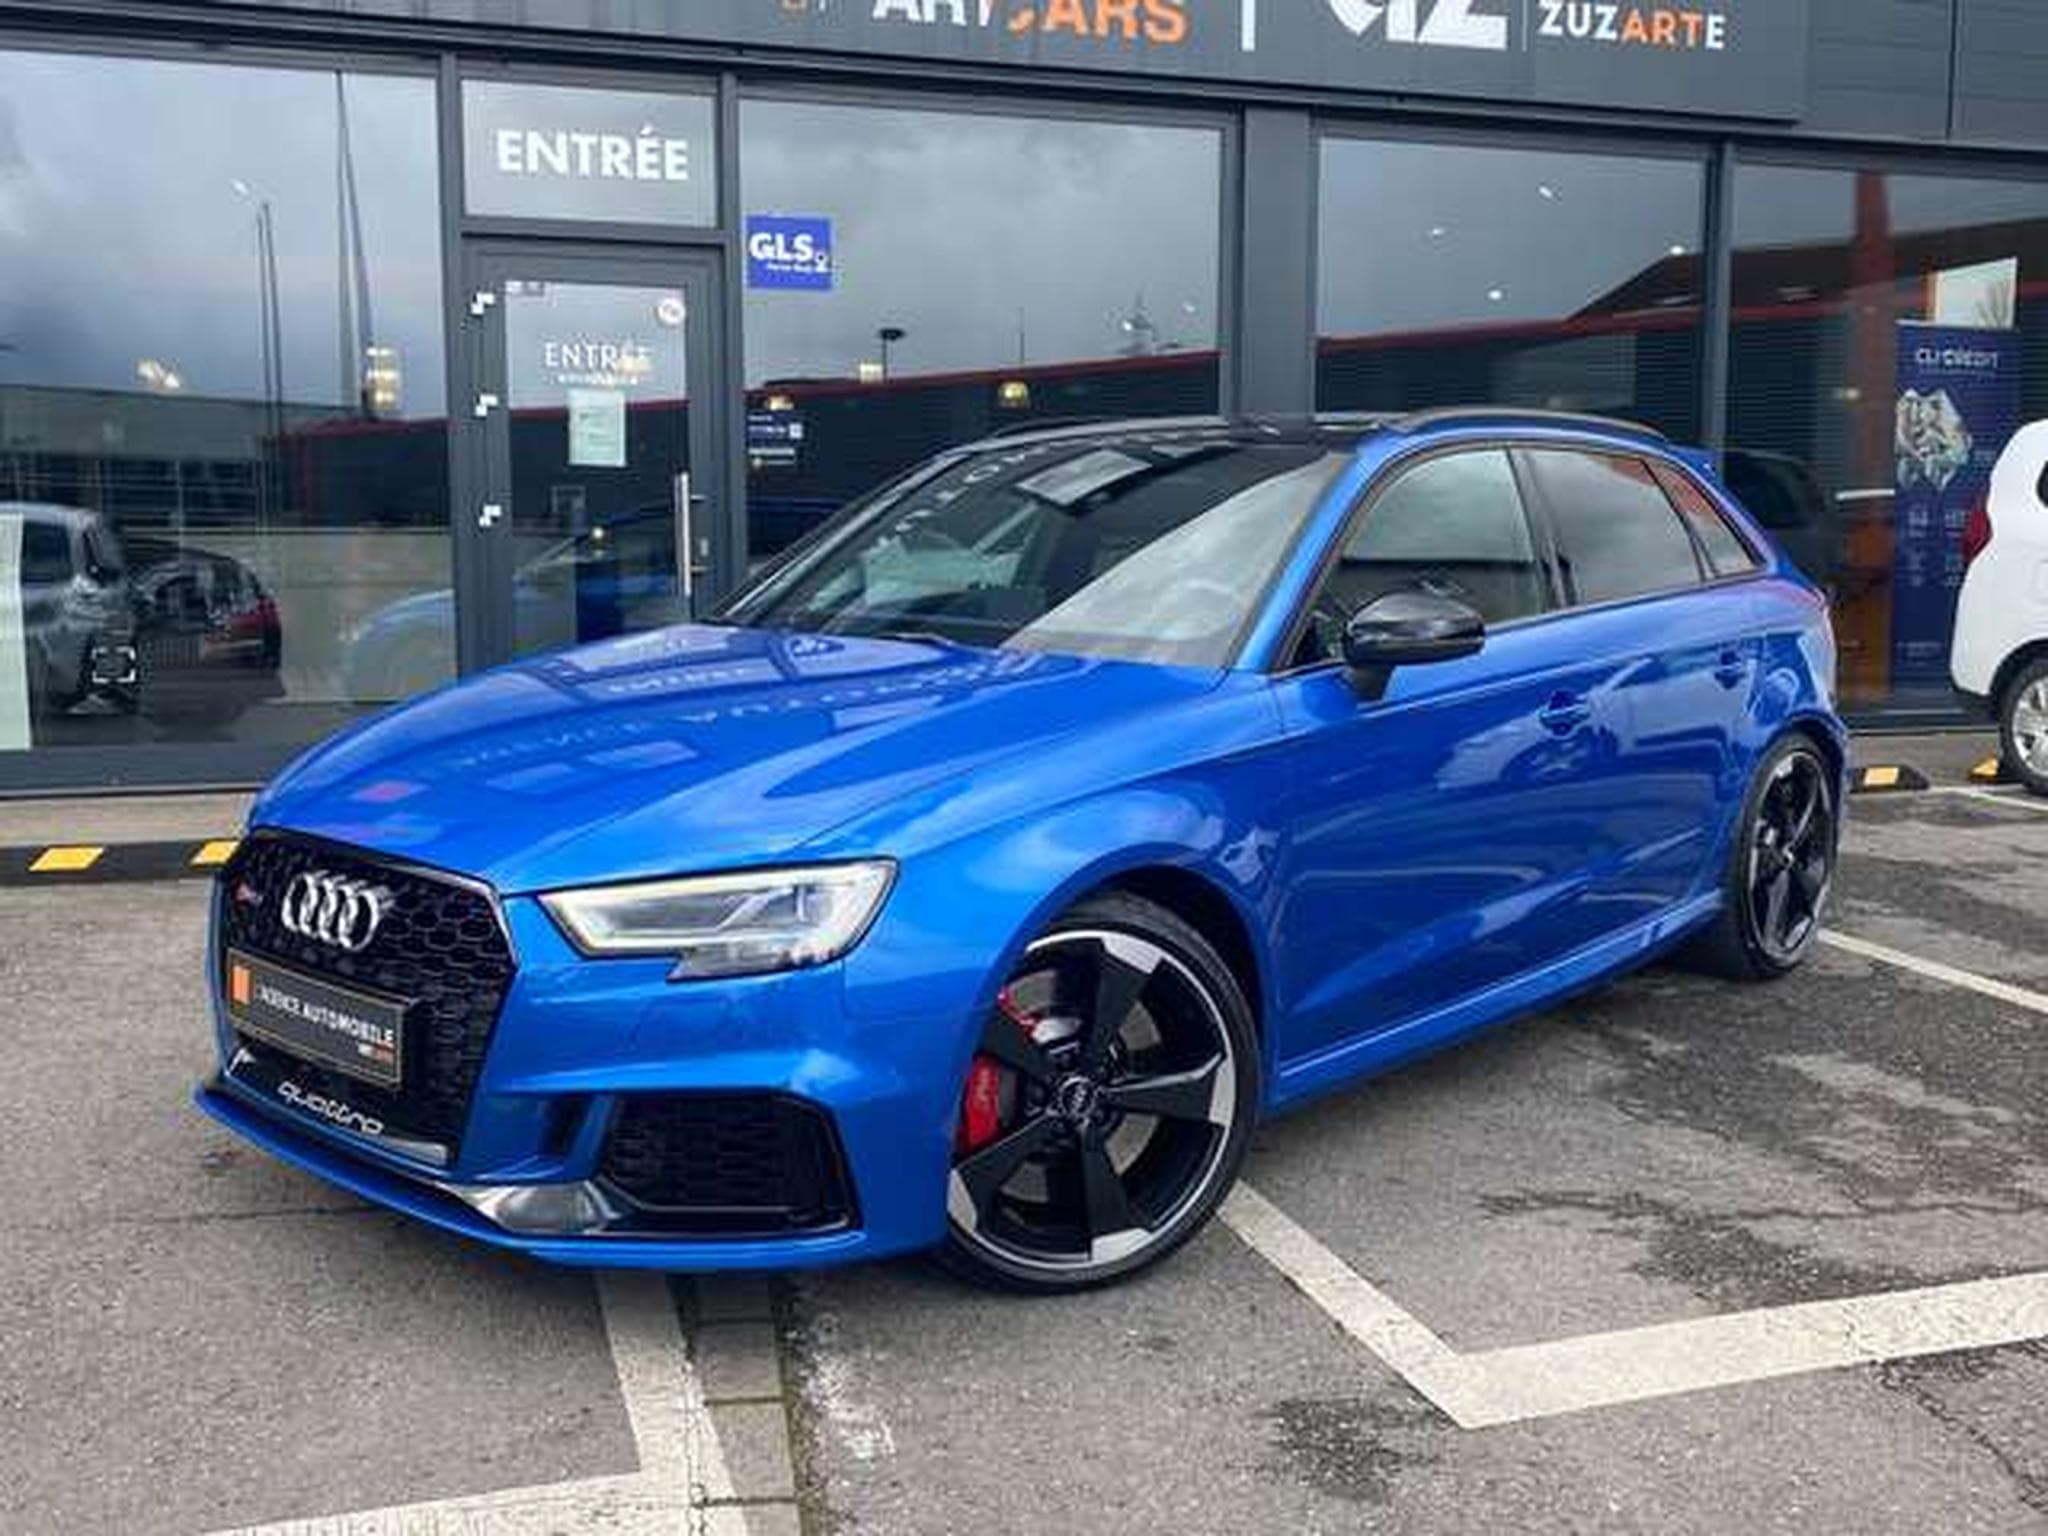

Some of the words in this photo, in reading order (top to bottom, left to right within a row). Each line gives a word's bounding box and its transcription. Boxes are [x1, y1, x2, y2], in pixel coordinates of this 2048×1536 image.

[1538, 0, 1727, 49] ZUZARTE
[496, 124, 688, 181] ENTRÉE
[749, 232, 814, 262] GLS
[277, 1080, 385, 1135] quattro
